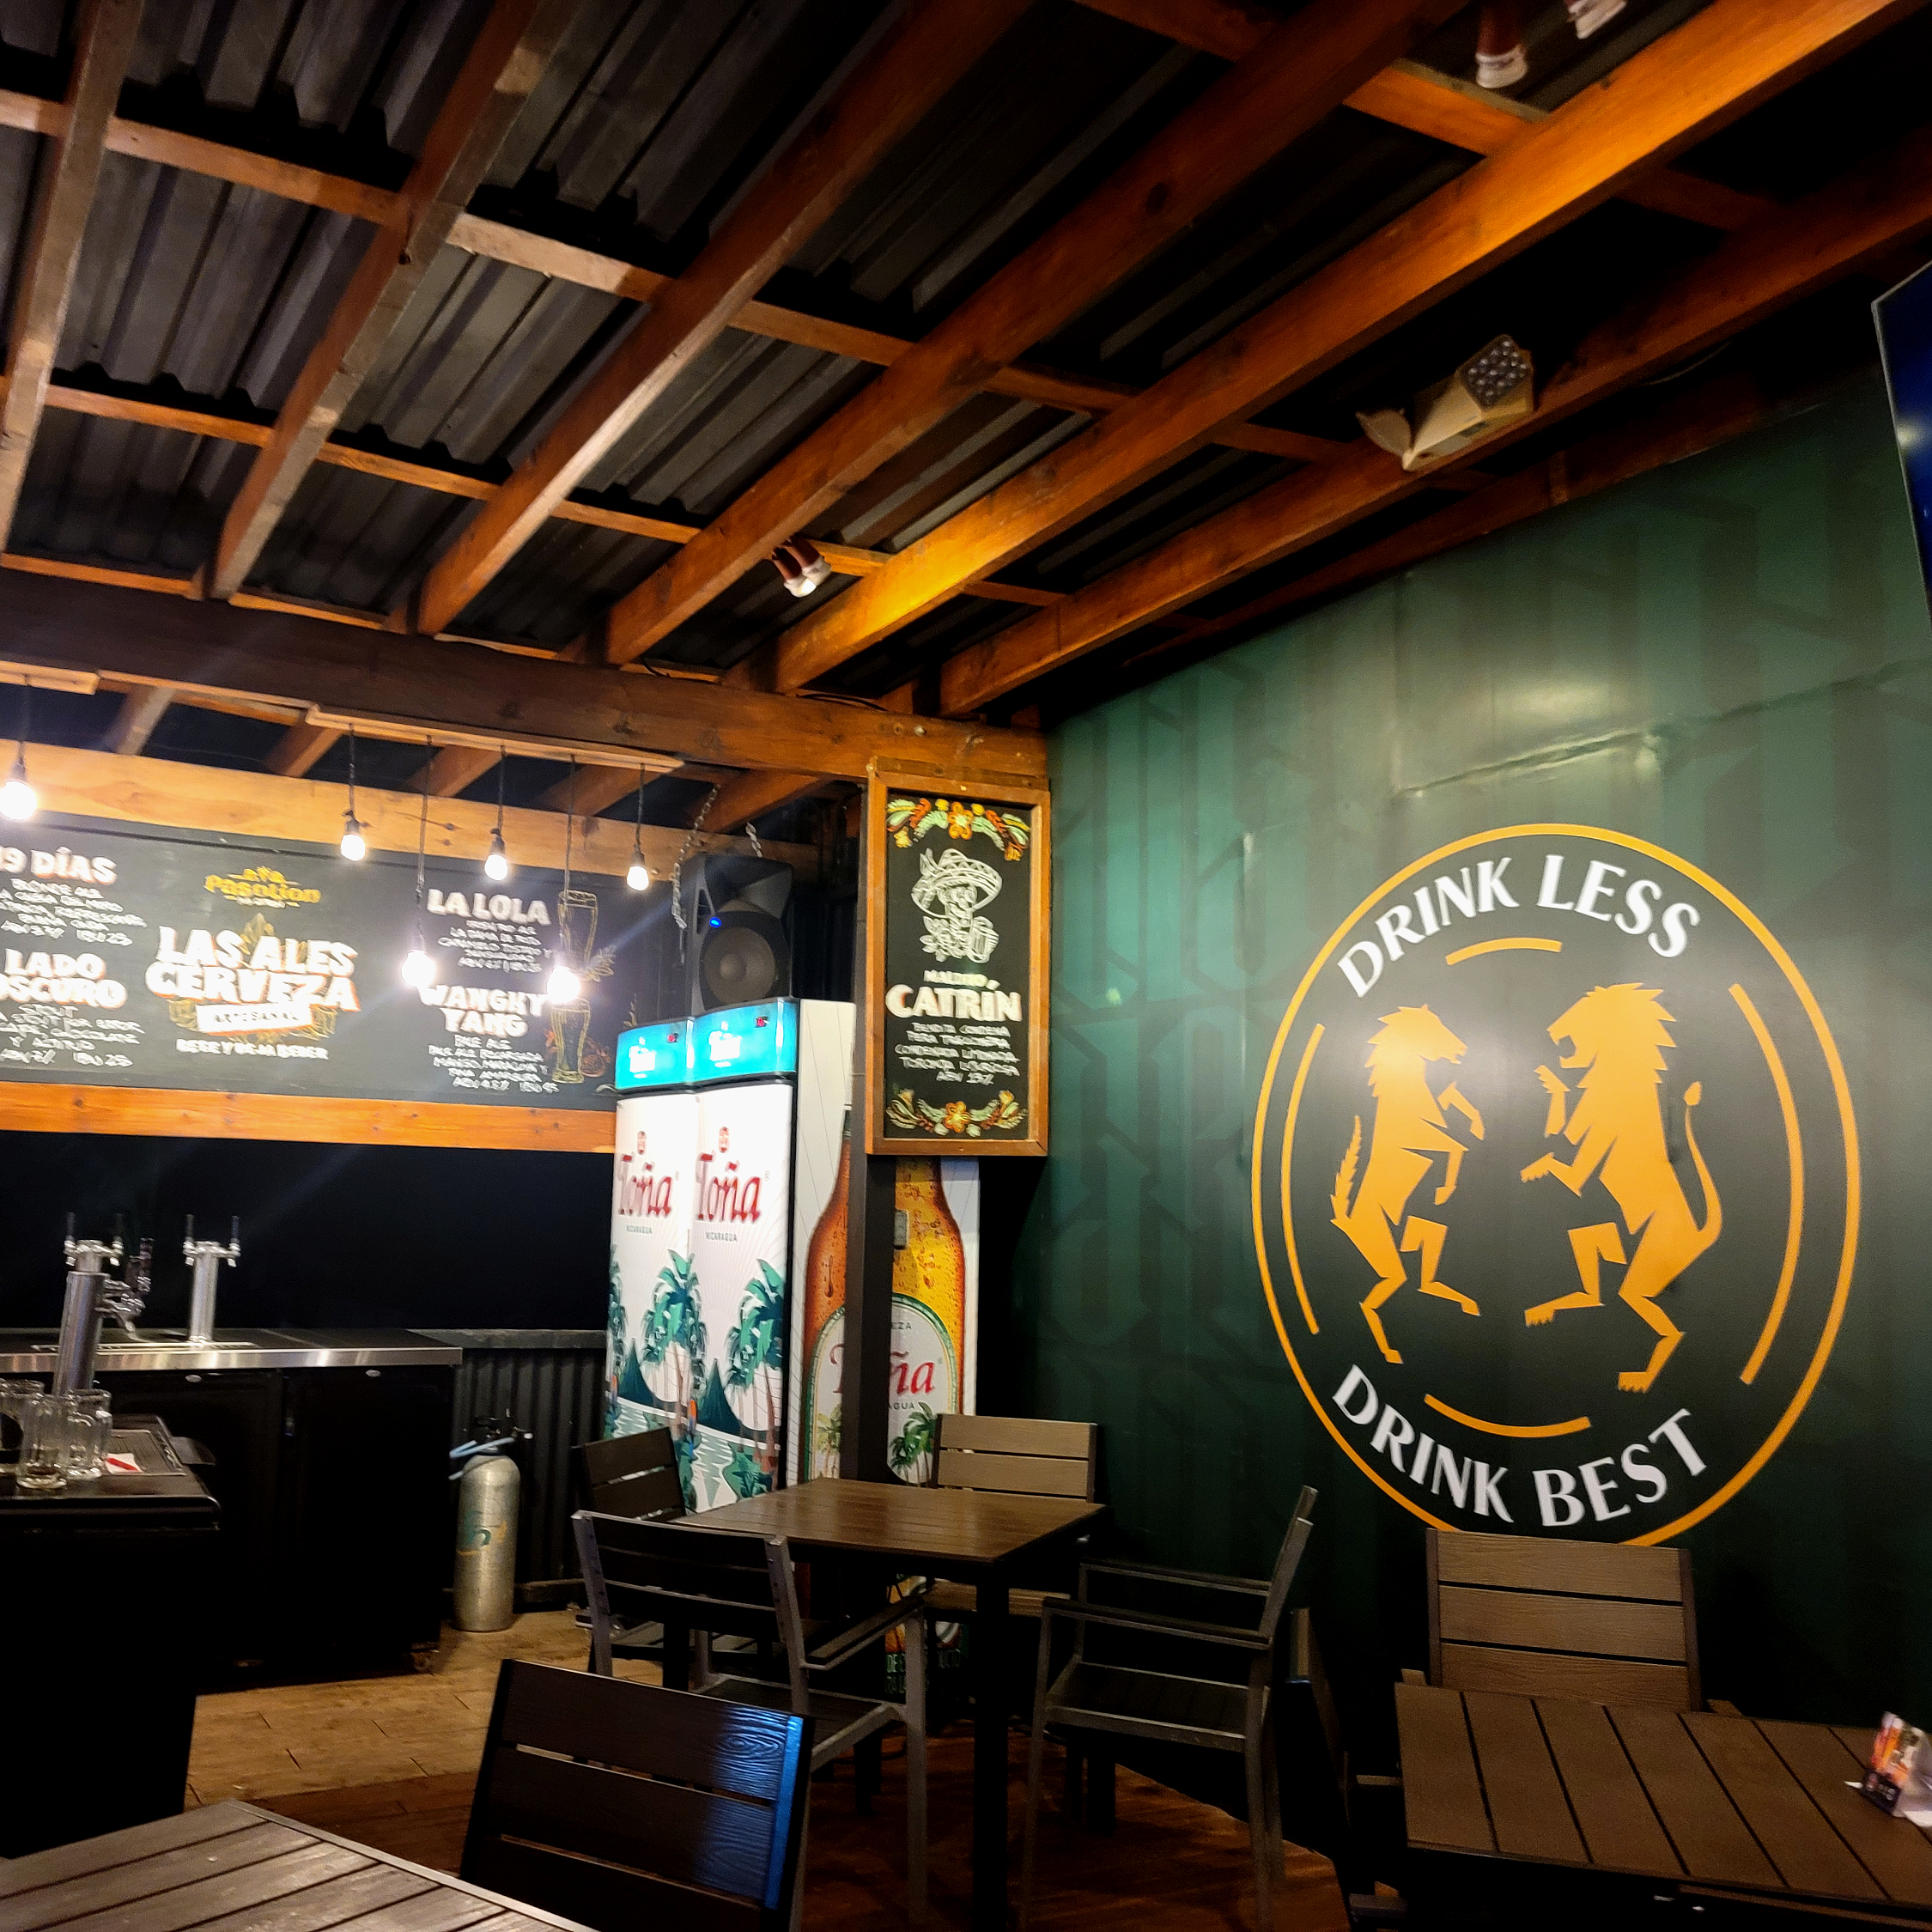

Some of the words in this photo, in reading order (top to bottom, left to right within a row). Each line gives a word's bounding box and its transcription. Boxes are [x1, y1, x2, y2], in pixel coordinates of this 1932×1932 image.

[30, 846, 118, 885] DÍAS
[427, 889, 472, 917] LA
[472, 892, 551, 926] LOLA
[1337, 857, 1518, 998] DRINK
[1535, 854, 1700, 958] LESS
[4, 949, 106, 980] LADO
[155, 926, 245, 969] LAS
[249, 935, 358, 978] ALES
[144, 961, 361, 1012] CERVEZA
[885, 980, 1023, 1022] CATRÍN
[440, 1007, 528, 1037] YANG
[695, 1150, 761, 1224] Toña
[706, 1230, 738, 1242] NICARAGUA
[1331, 1364, 1514, 1523] DRINK
[1532, 1408, 1707, 1527] BEST
